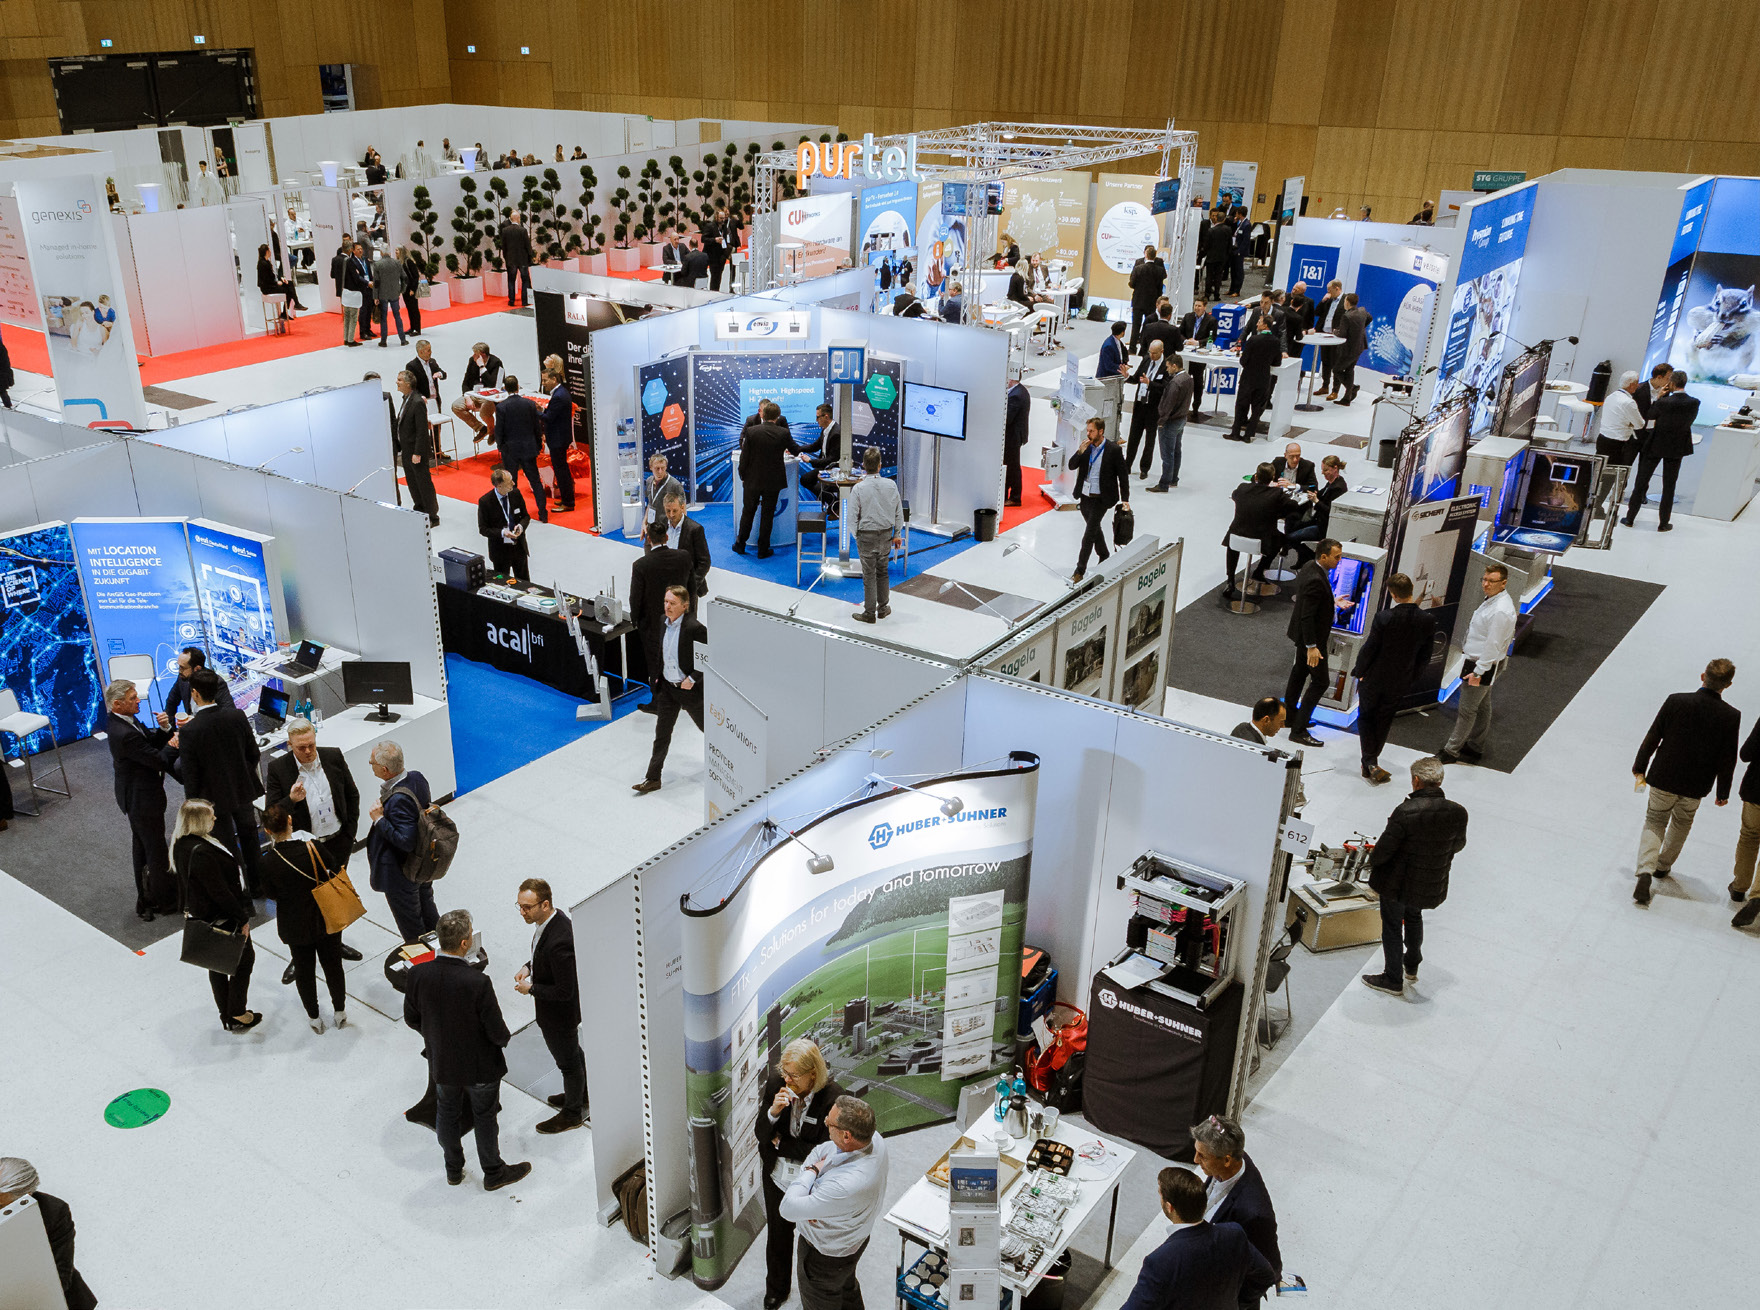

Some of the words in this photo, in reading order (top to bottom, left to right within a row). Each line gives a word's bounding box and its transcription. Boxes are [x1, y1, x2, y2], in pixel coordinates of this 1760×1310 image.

[796, 133, 925, 190] purtel
[1040, 176, 1063, 184] Netzwerk
[1476, 174, 1491, 182] STG
[1492, 174, 1522, 182] GRUPPE
[32, 210, 83, 224] genexis
[1471, 225, 1492, 245] Prysmian
[1303, 265, 1322, 280] 1&1
[567, 311, 585, 321] RALA
[1217, 312, 1233, 335] 1&1
[567, 341, 581, 353] Der
[568, 354, 582, 365] ihre
[1212, 373, 1234, 389] 1&1
[748, 387, 778, 395] Hightech.
[780, 387, 816, 395] Highspeed.
[1420, 508, 1445, 518] SICHERT
[1450, 501, 1478, 511] ELECTRONIC
[103, 546, 157, 555] LOCATION
[90, 557, 162, 567] INTELLIGENCE
[433, 565, 442, 573] 512
[3, 574, 17, 582] THE
[117, 568, 151, 576] GIGABIT-
[1137, 562, 1167, 591] Bagela
[4, 576, 32, 587] SCIENCE
[6, 585, 16, 593] OF
[7, 587, 31, 598] WHERE
[1071, 606, 1103, 636] Bagela
[486, 622, 528, 655] acal
[531, 631, 544, 647] bfi
[1000, 647, 1036, 676] Bagela
[709, 703, 725, 726] Easy
[726, 717, 757, 754] Solutions
[709, 742, 734, 772] PROVIDER
[709, 755, 743, 794] MANAGEMENT
[709, 768, 736, 801] SOFTWARE
[1287, 830, 1308, 844] 612
[730, 975, 751, 1000] FTTx
[760, 917, 808, 966] Solutions
[809, 907, 829, 926] for
[832, 886, 877, 915] today
[882, 871, 914, 894] and
[919, 861, 1002, 882] tomorrow
[1118, 1000, 1203, 1039] HUBER+SUHNER
